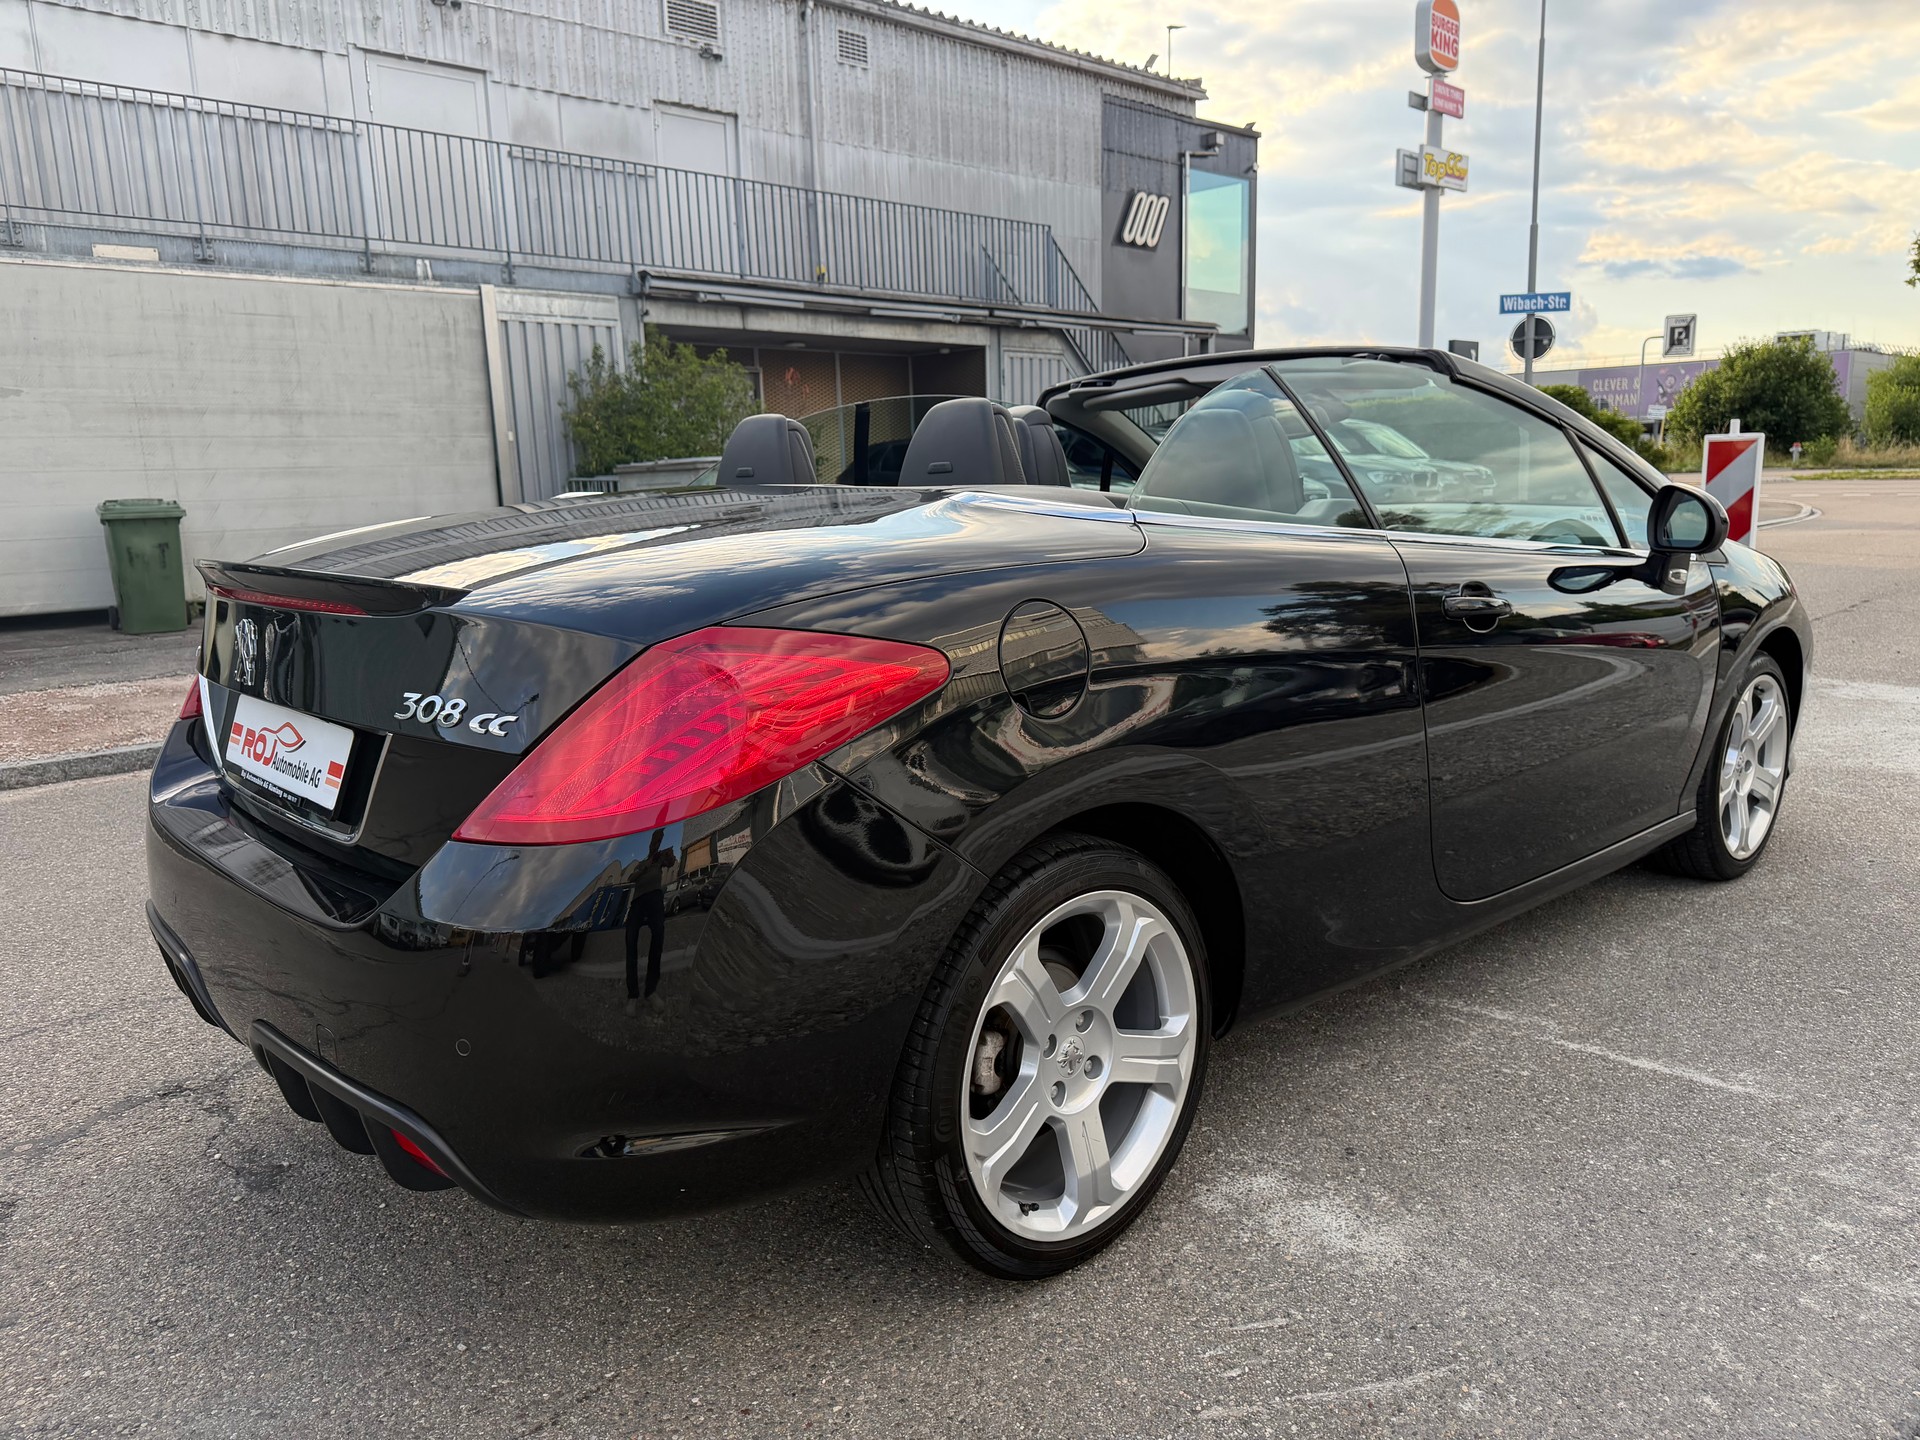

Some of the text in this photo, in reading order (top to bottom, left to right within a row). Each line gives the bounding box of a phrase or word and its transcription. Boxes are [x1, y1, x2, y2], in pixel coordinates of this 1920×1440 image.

[1431, 12, 1459, 38] BURGER
[1431, 28, 1459, 58] KING
[1502, 295, 1567, 312] Wibach-Str.
[1593, 377, 1628, 392] CLEVER
[394, 692, 469, 729] 308
[271, 752, 322, 789] Automobile AG
